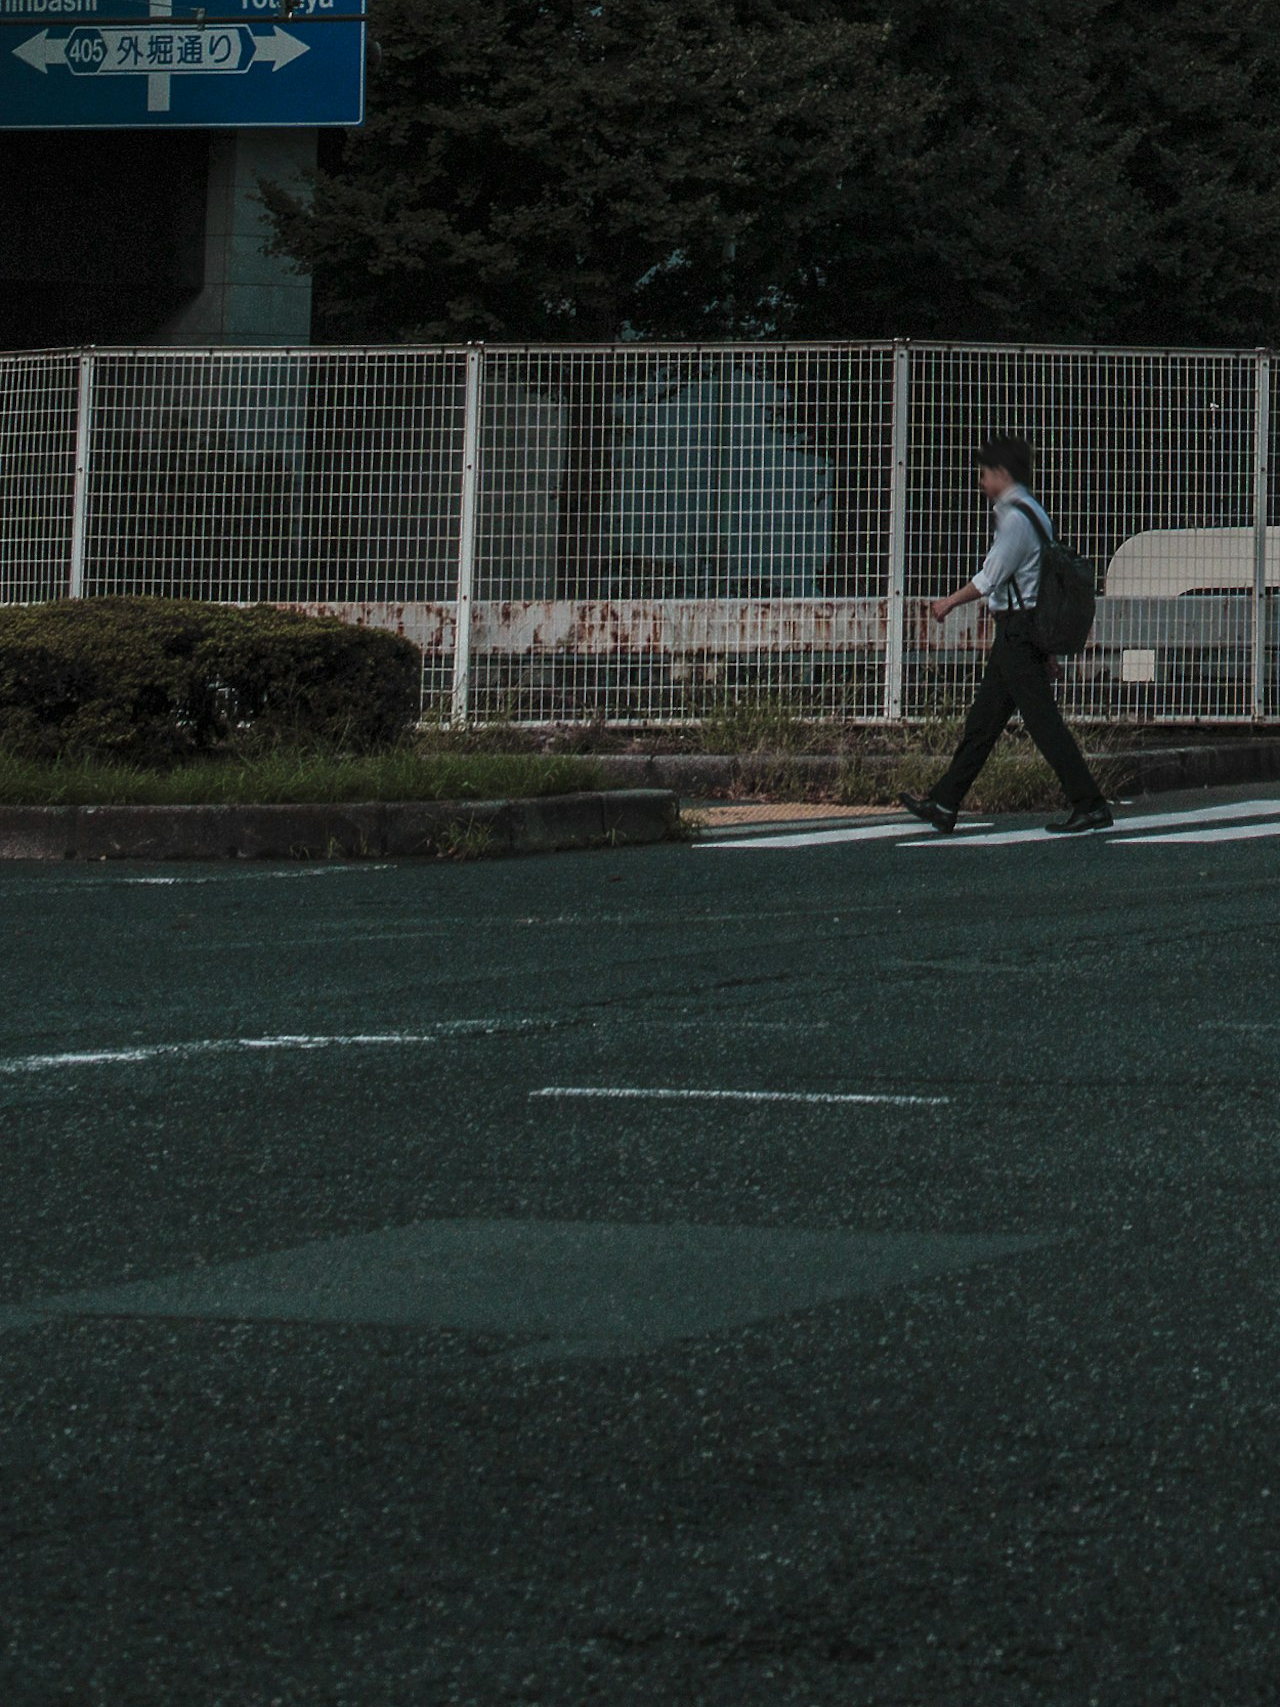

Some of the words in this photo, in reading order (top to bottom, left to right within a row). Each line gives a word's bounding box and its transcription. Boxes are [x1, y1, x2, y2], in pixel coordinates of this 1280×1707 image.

[69, 39, 103, 63] 405
[116, 35, 231, 66] 外堀通り
